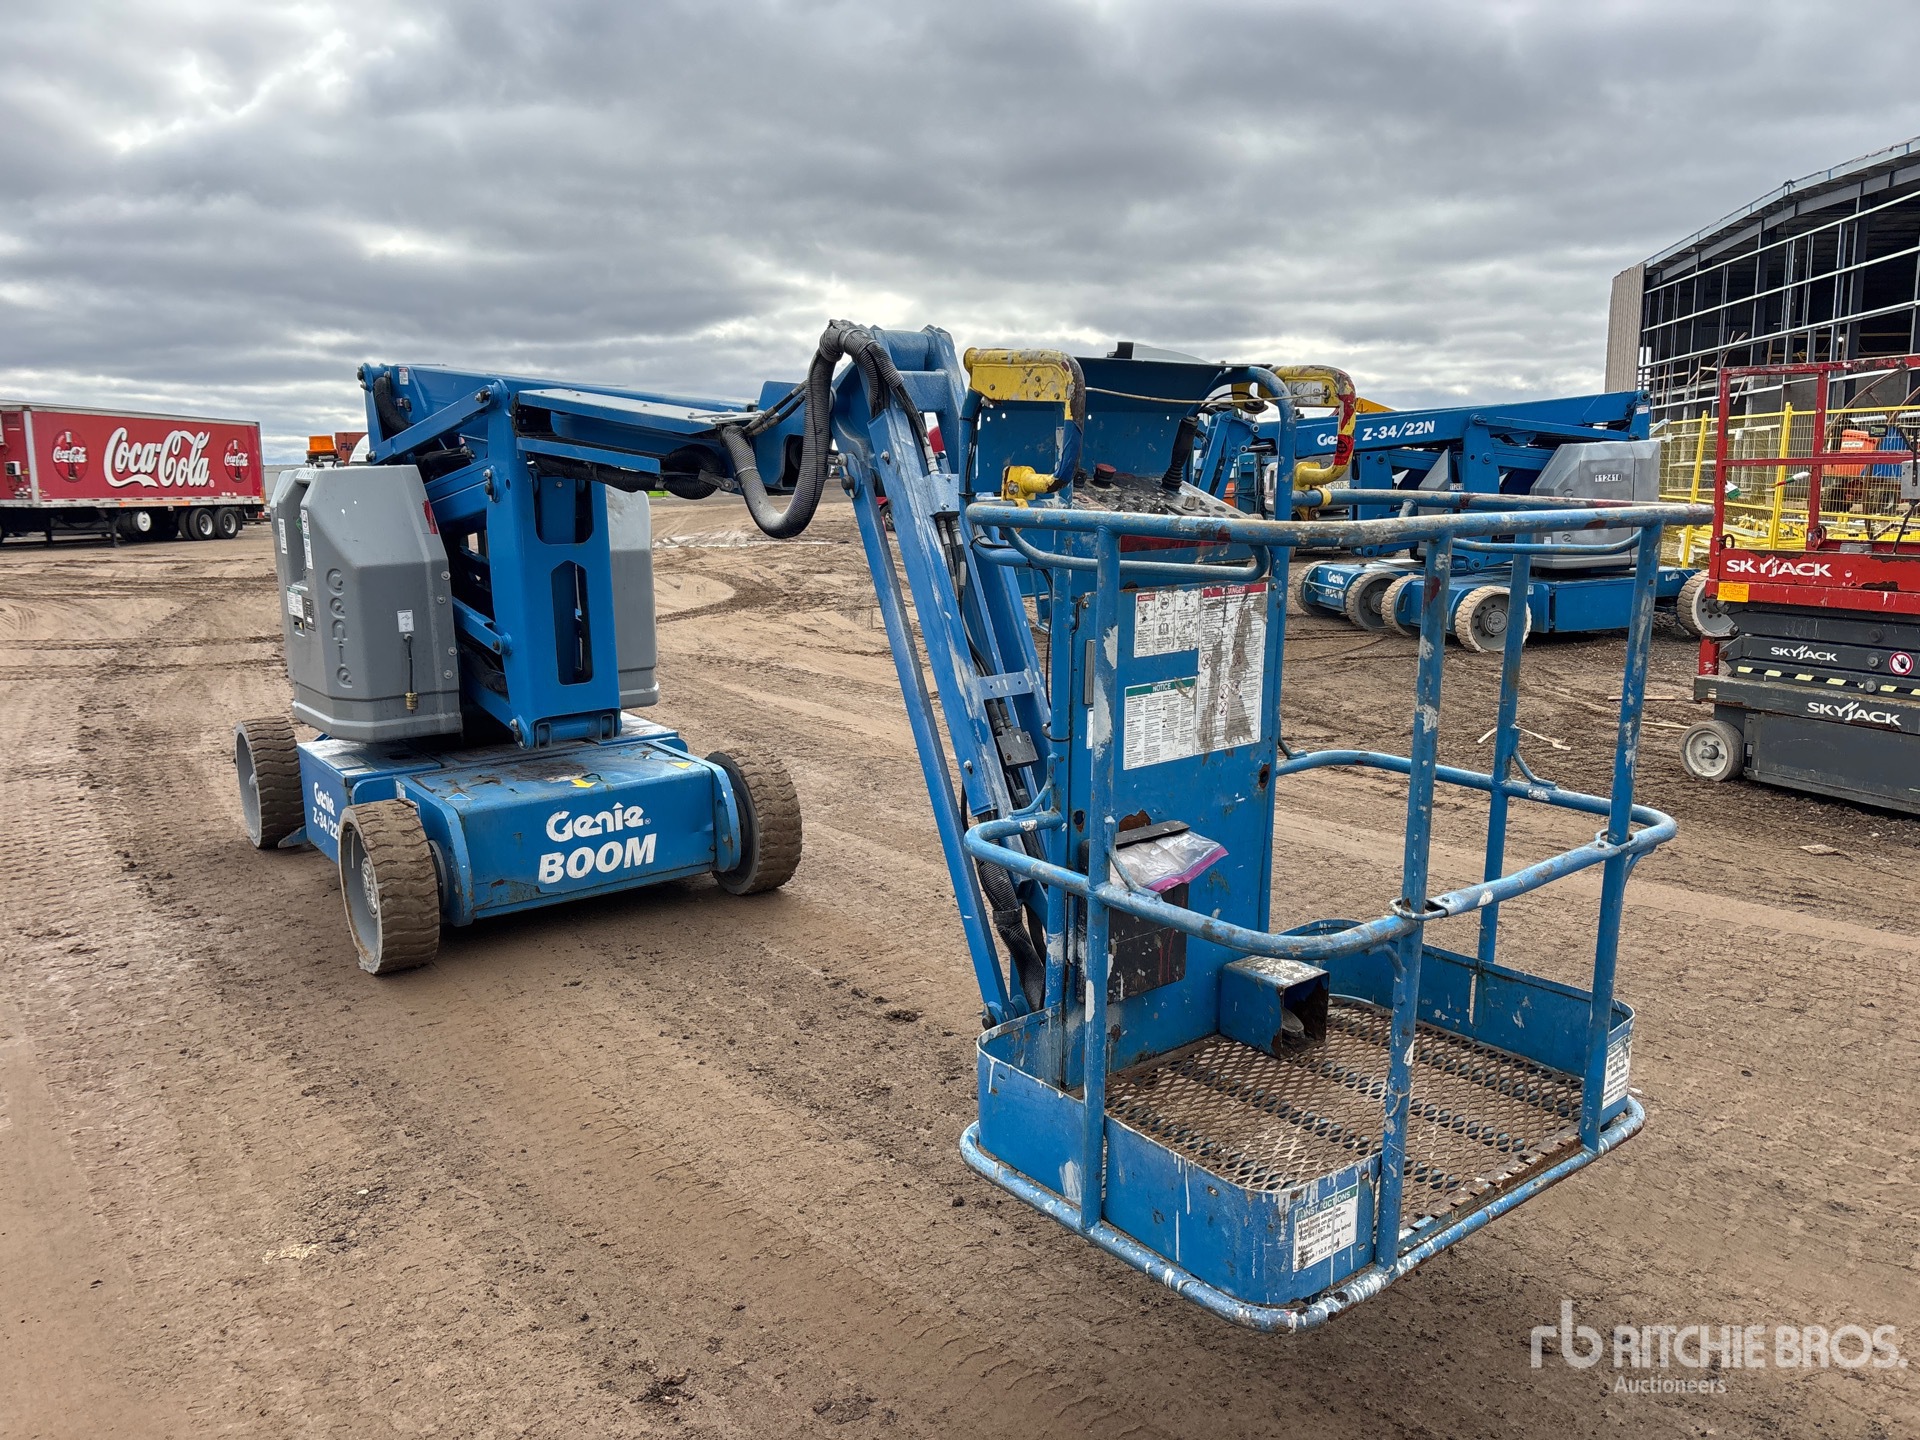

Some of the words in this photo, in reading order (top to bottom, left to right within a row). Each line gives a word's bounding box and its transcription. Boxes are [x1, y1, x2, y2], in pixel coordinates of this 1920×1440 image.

[1362, 420, 1435, 441] Z-34/22N
[53, 446, 87, 463] Coca-Cola
[104, 427, 210, 487] Coca-Cola
[224, 452, 249, 467] Coca-Cola
[1726, 556, 1832, 577] SKYJACK
[1771, 645, 1838, 662] SKYJACK
[1153, 683, 1171, 692] NOTICE
[1807, 701, 1901, 726] SKYJACK
[314, 782, 336, 817] Genie
[546, 802, 644, 842] Genie
[538, 833, 657, 884] BOOM
